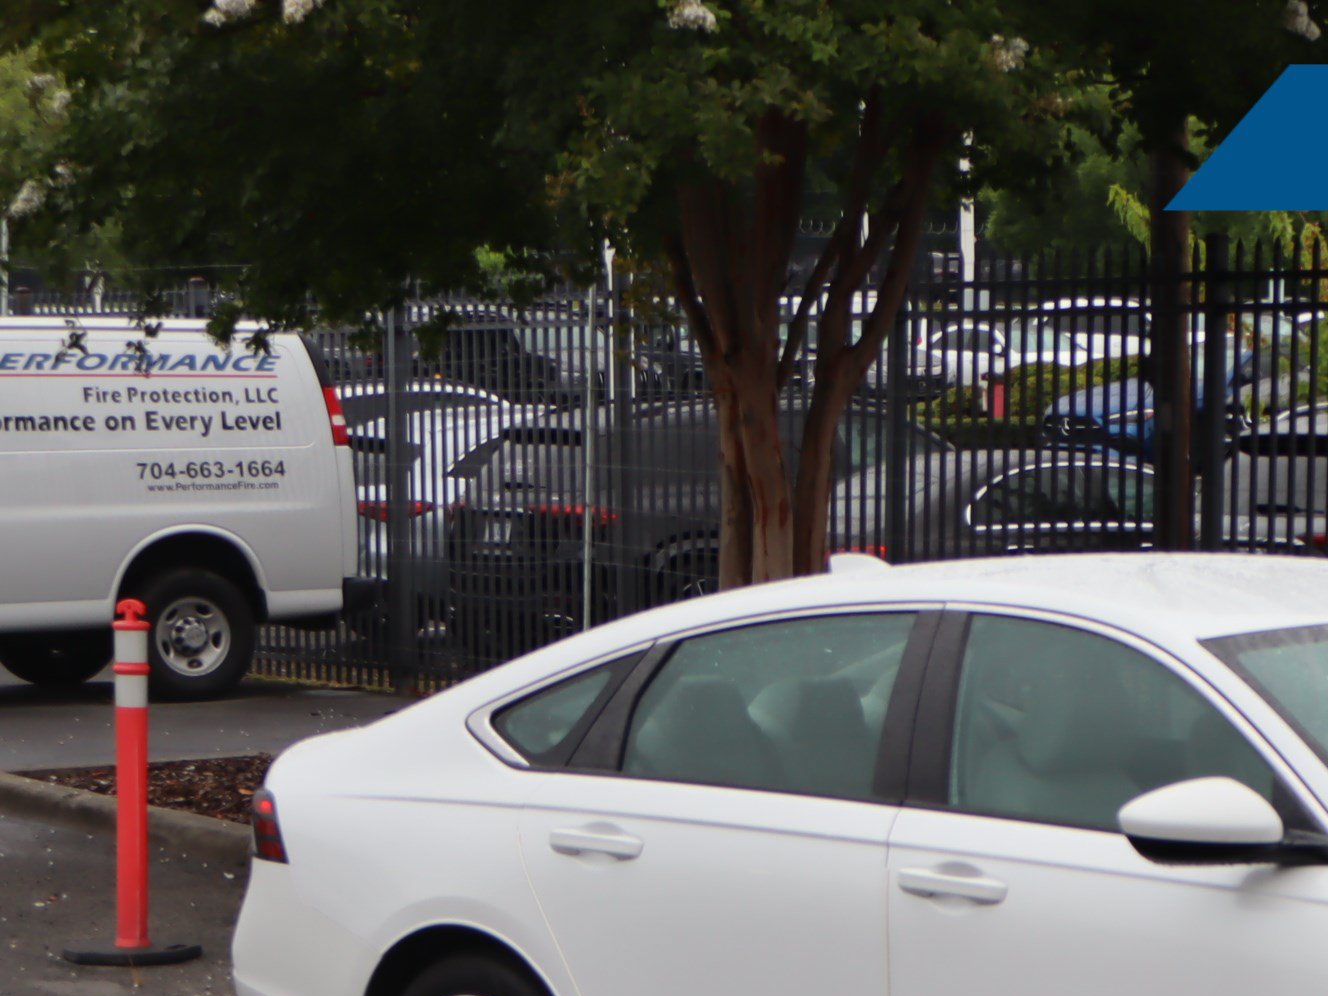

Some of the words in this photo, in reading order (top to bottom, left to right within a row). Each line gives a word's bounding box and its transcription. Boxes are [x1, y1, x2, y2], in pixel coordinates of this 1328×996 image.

[83, 387, 122, 404] Fire
[127, 387, 240, 406] Protection,
[245, 387, 279, 404] LLC
[0, 415, 96, 432] rmance
[105, 414, 136, 432] on
[146, 411, 212, 437] Every
[222, 411, 281, 432] Level
[136, 460, 286, 480] 704-663-1664
[148, 481, 280, 493] www.PerformanceFire.com
